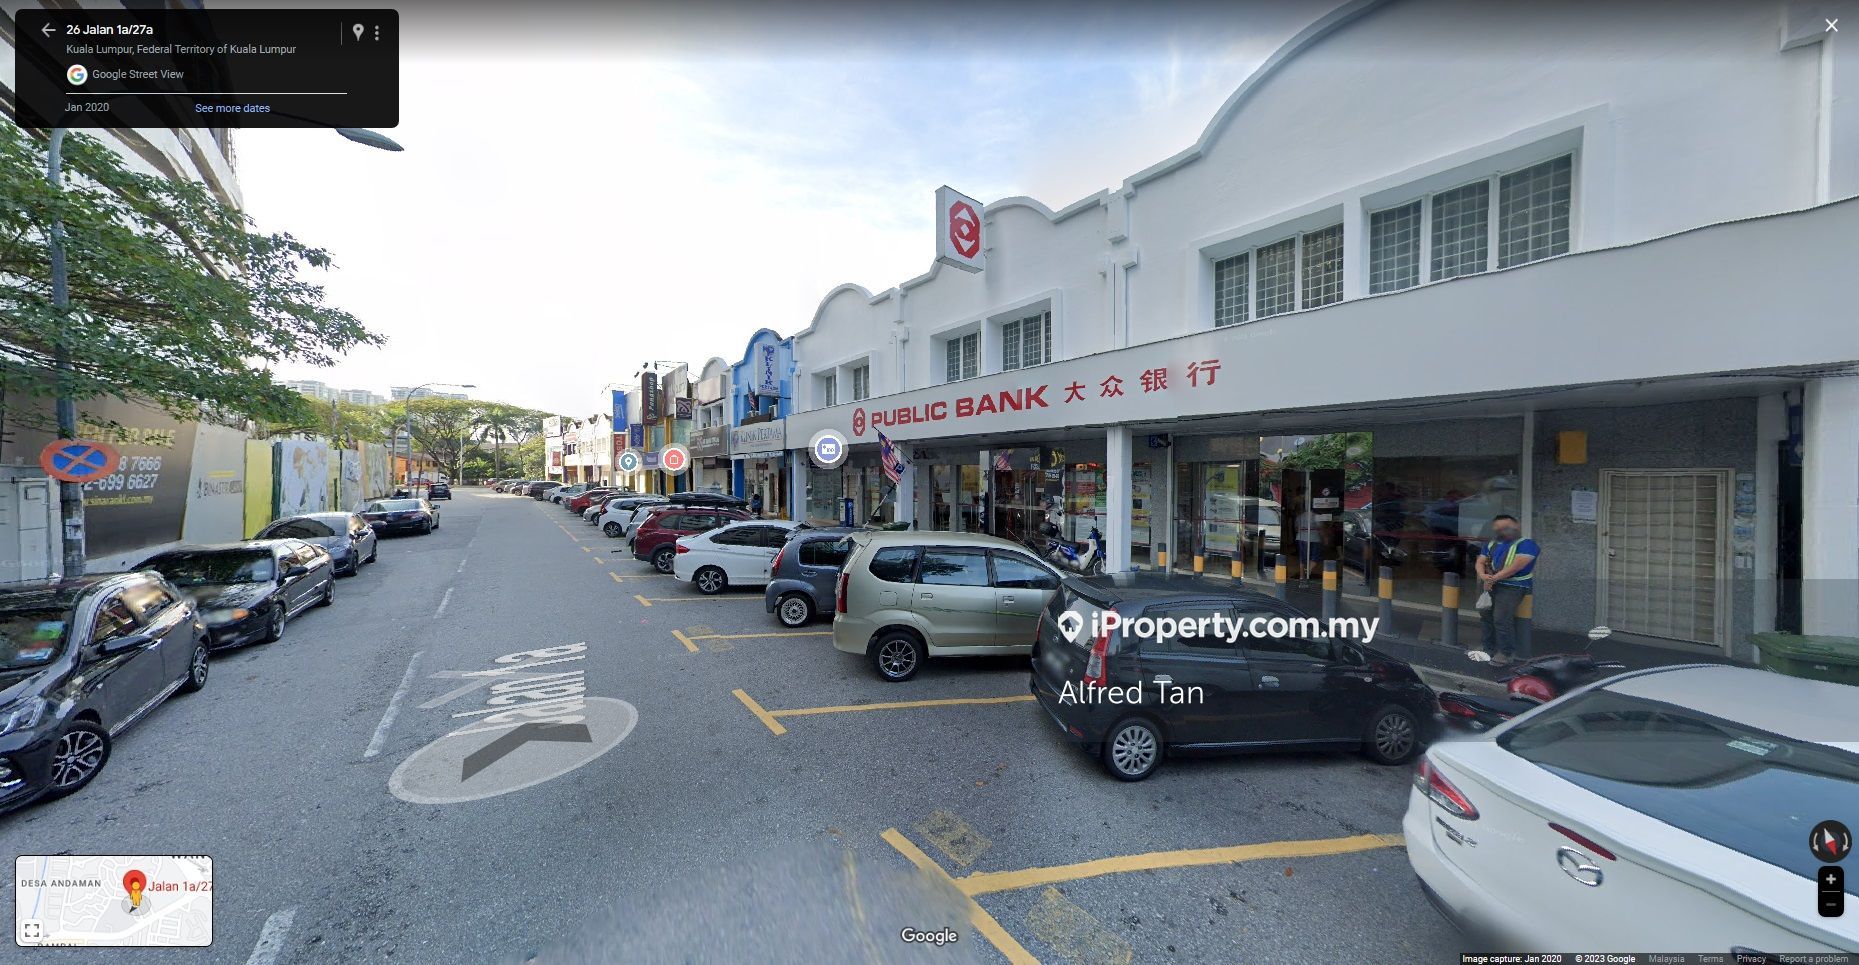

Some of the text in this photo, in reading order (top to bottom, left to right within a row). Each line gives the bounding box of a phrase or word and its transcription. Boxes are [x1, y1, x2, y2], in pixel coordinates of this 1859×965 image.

[1064, 359, 1222, 404] 大众银行
[872, 385, 1049, 428] PUBLIC BANK
[131, 455, 162, 471] 7666
[127, 473, 158, 490] 6627
